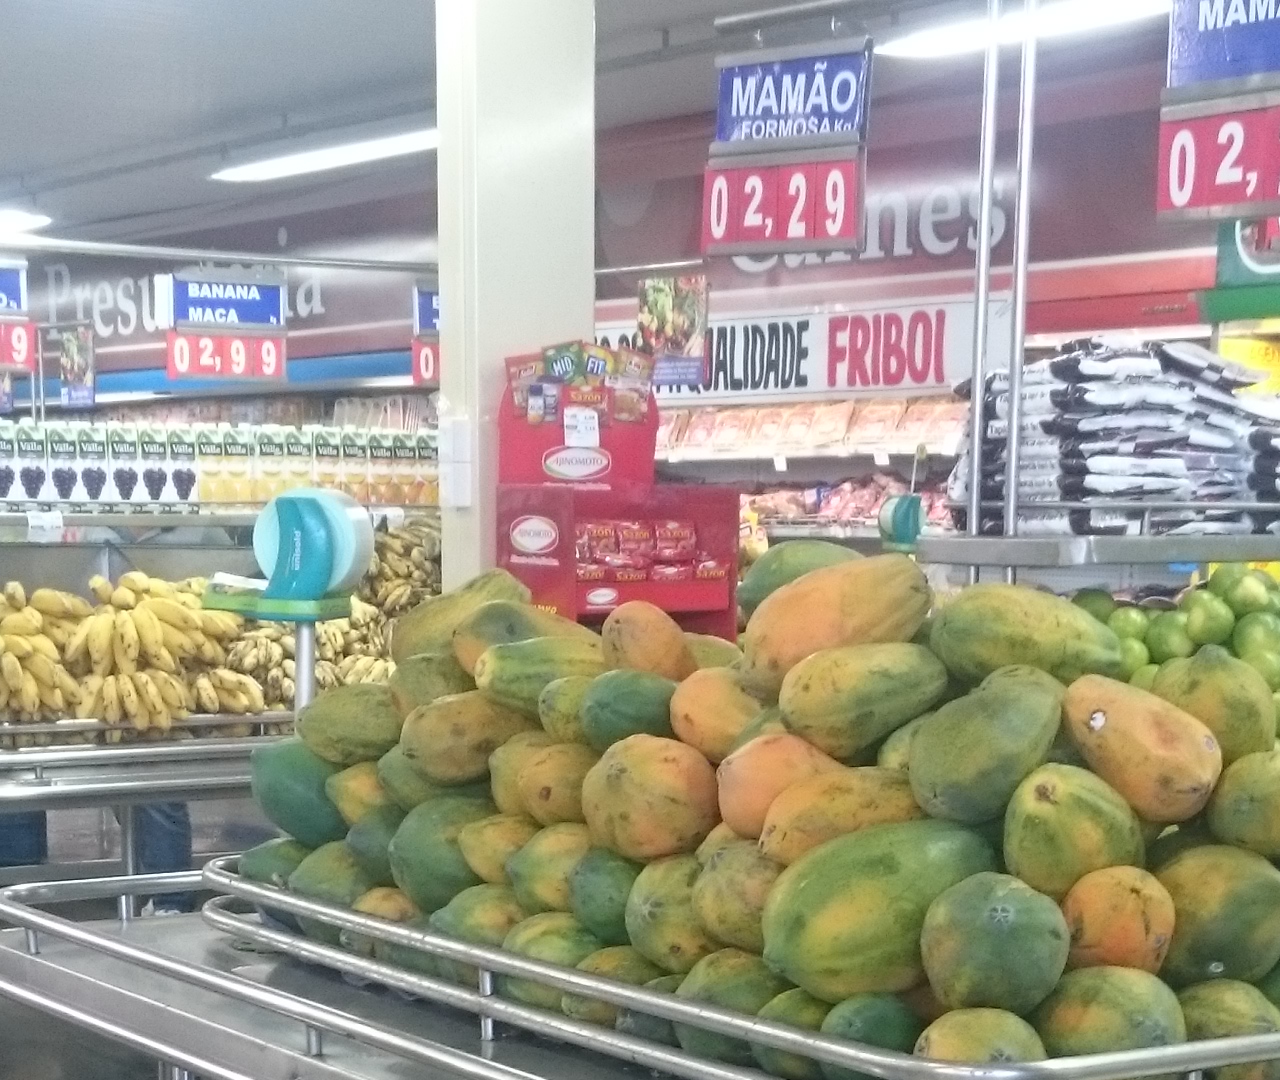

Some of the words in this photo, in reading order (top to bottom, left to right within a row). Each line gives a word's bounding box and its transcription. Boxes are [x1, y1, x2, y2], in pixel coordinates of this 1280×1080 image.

[731, 62, 857, 117] MAMÃO
[740, 113, 831, 141] FORMOSA
[709, 168, 846, 240] 02,29
[187, 281, 260, 301] BANANA
[173, 337, 277, 375] 02,99
[586, 355, 607, 376] FIT
[687, 319, 810, 394] UALIDADE
[826, 309, 946, 388] FRIBOI
